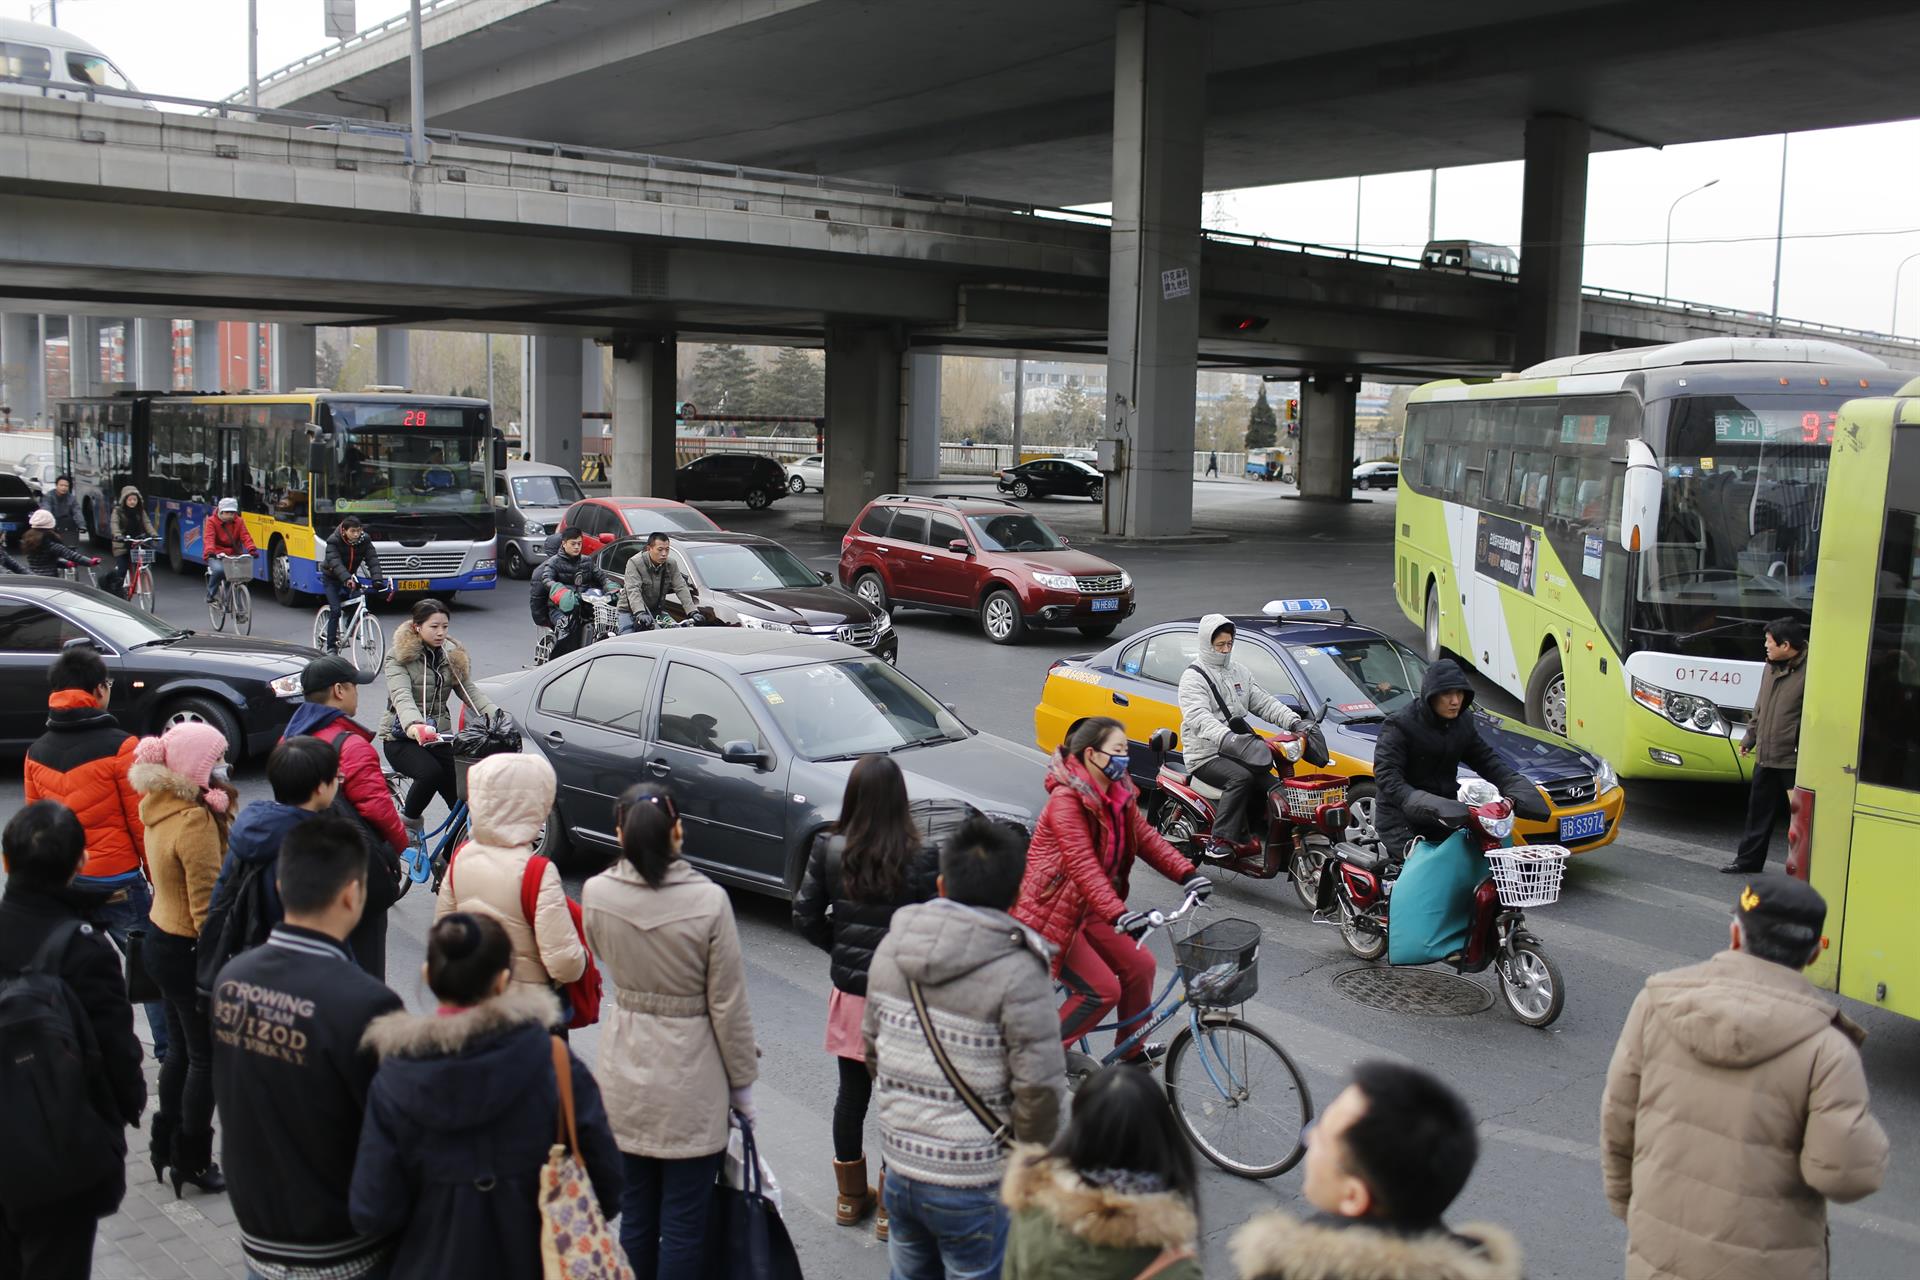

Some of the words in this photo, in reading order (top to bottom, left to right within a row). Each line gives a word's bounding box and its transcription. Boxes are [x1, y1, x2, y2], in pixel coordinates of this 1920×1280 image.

[402, 410, 427, 426] 28
[1676, 668, 1742, 685] 017440
[256, 1004, 295, 1027] TEAM
[1134, 1014, 1163, 1039] GIANT
[246, 1016, 307, 1050] IZOD
